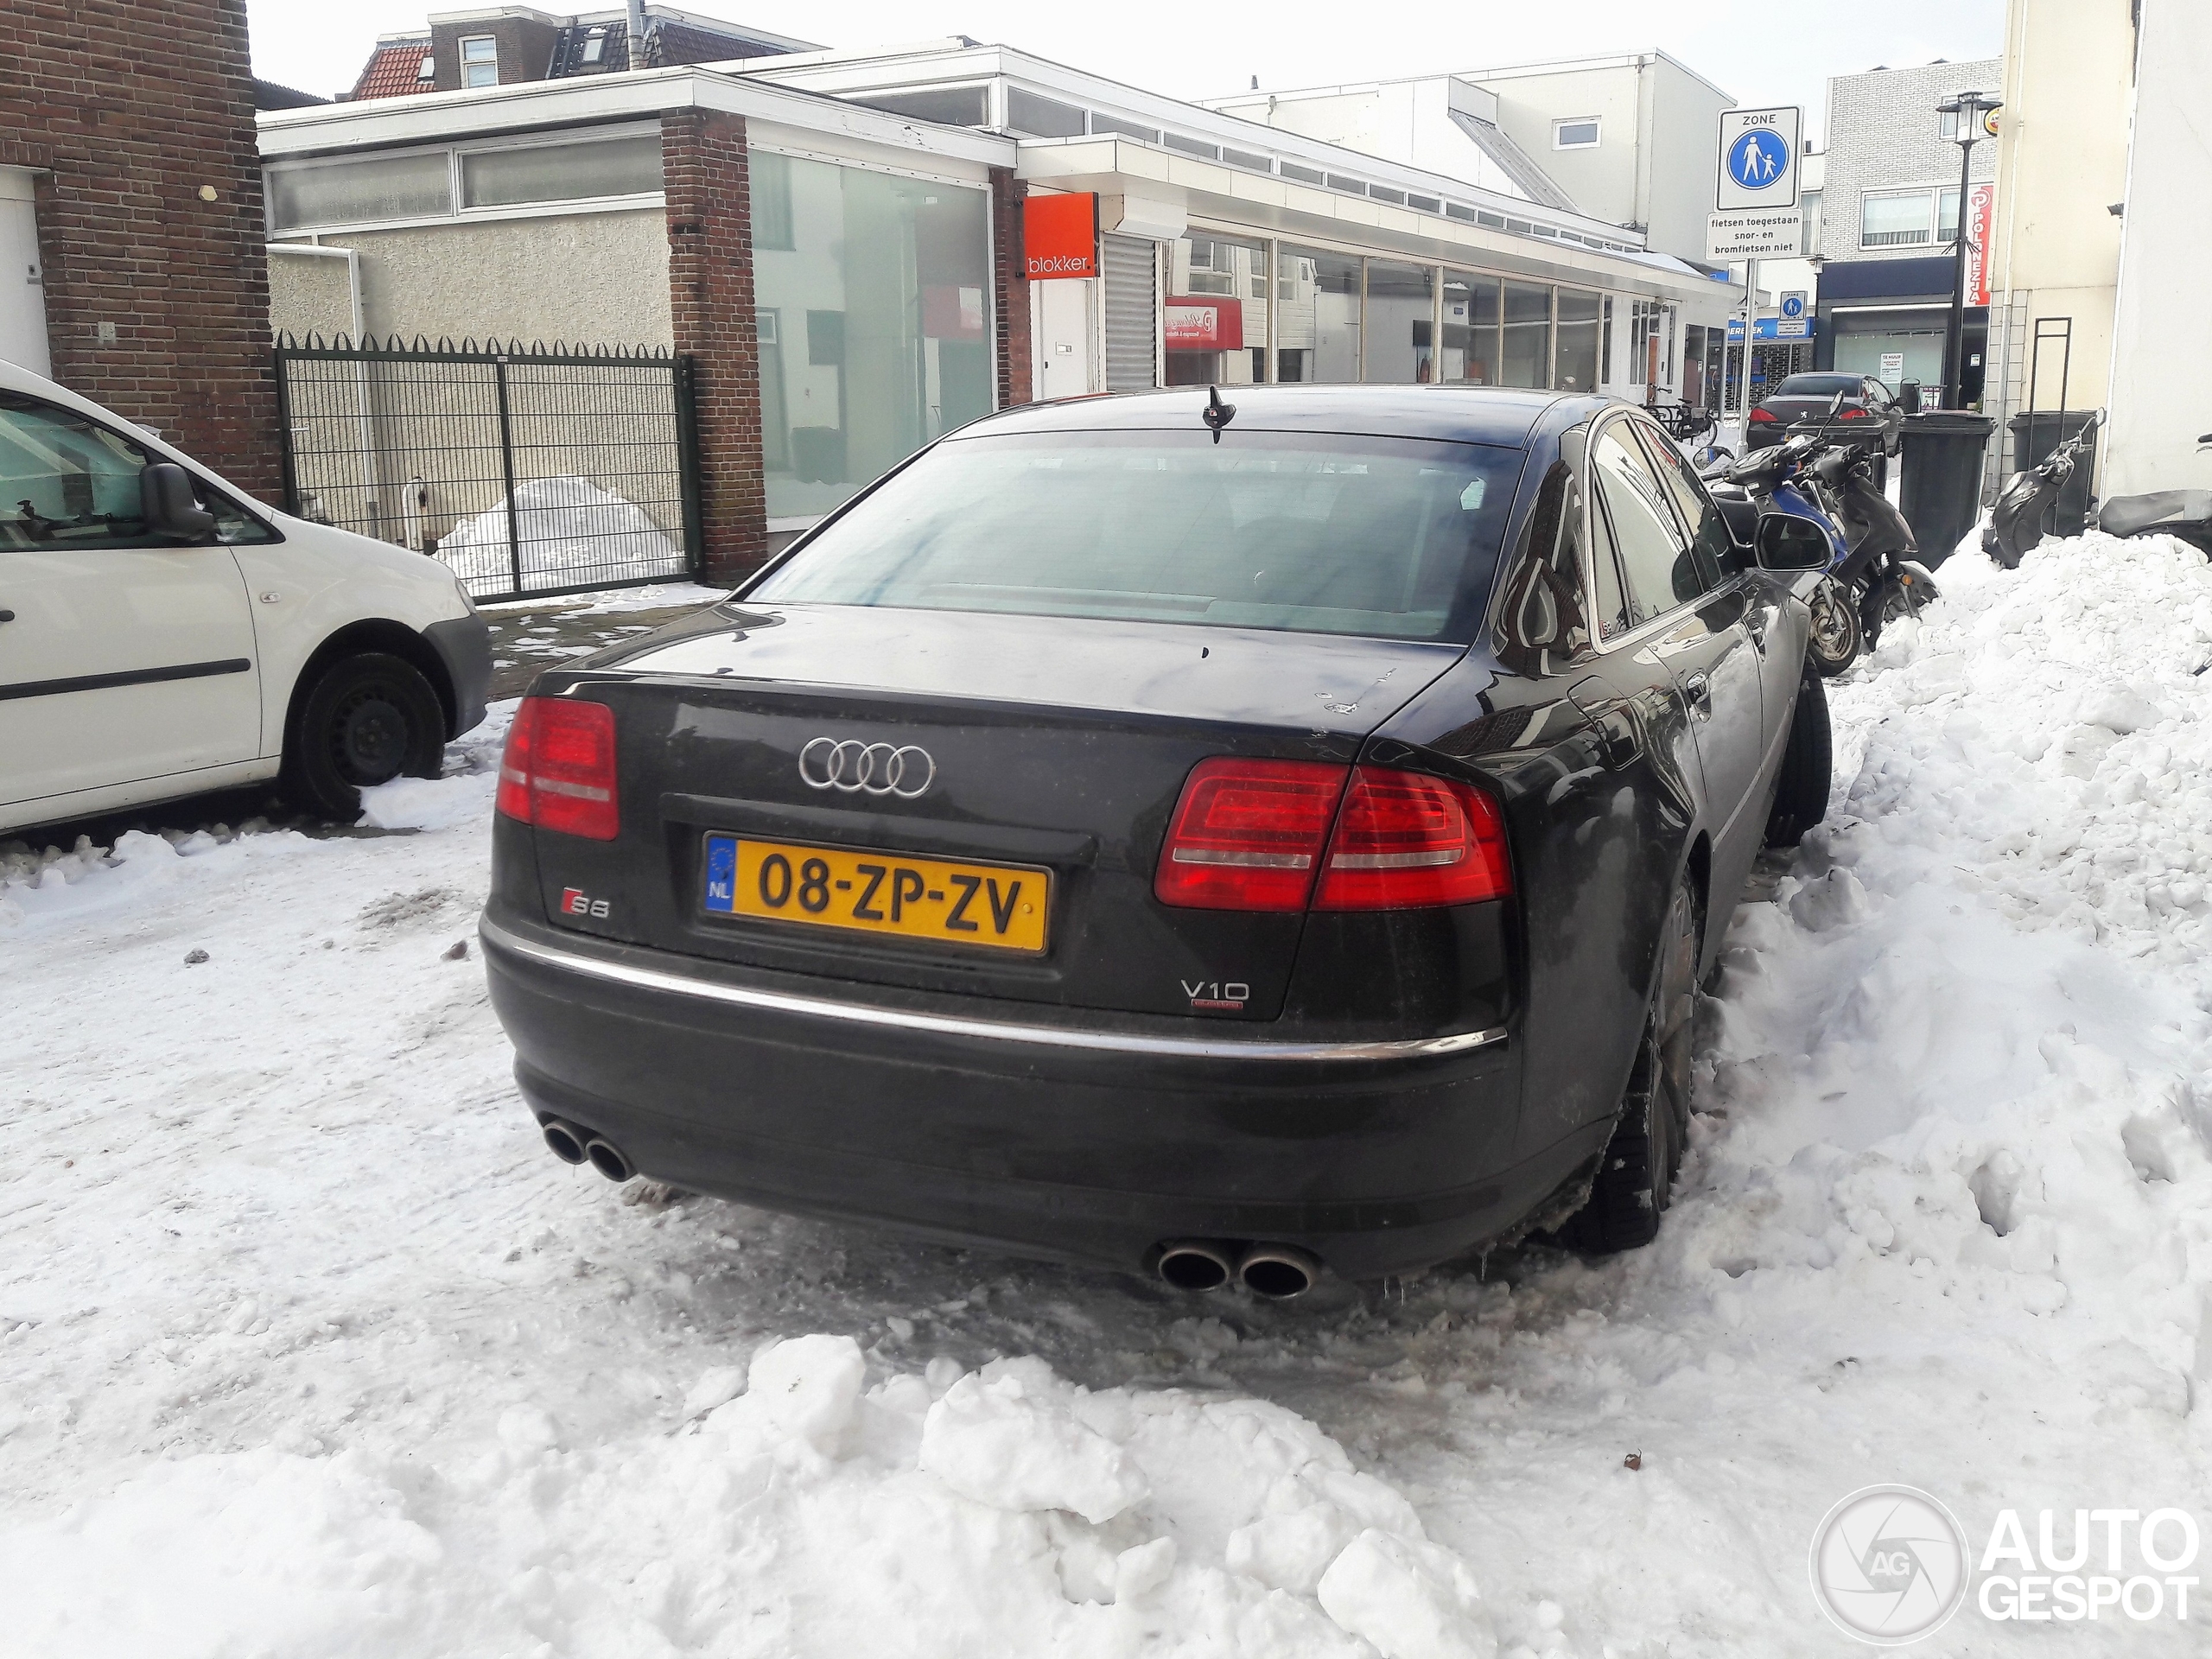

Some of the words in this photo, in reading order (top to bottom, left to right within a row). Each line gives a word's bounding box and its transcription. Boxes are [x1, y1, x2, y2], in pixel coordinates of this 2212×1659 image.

[1742, 114, 1777, 125] ZONE
[1746, 216, 1799, 227] toegestaan
[1715, 245, 1770, 254] bromfietsen
[1774, 243, 1793, 251] niet
[1969, 213, 1985, 302] POLONEZJA
[709, 881, 731, 900] NL
[759, 852, 1021, 935] 08-ZP-ZV
[570, 895, 610, 918] S8
[1180, 979, 1249, 1001] V10
